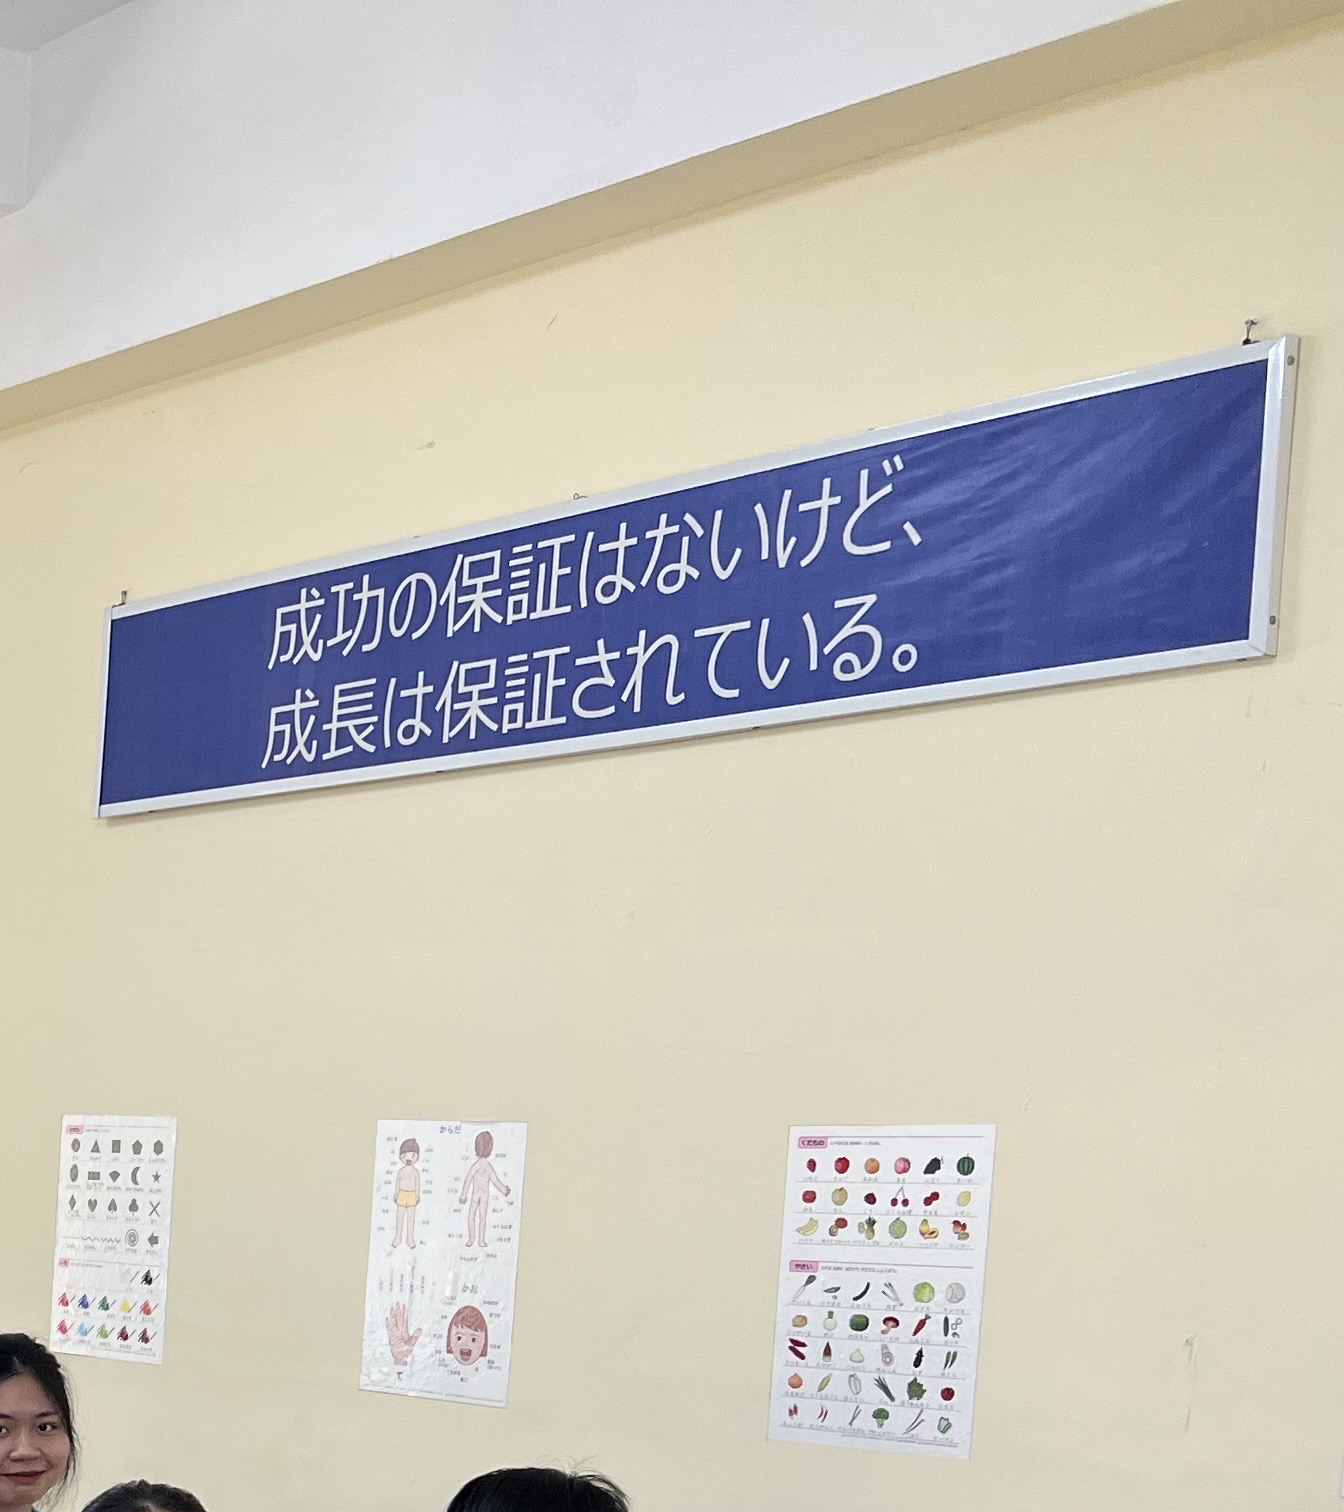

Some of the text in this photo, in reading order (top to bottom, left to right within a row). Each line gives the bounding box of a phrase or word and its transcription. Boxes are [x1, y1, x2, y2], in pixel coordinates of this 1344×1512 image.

[268, 454, 924, 670] 成功の保証はないけど、
[261, 593, 918, 771] 成長は保証されている。
